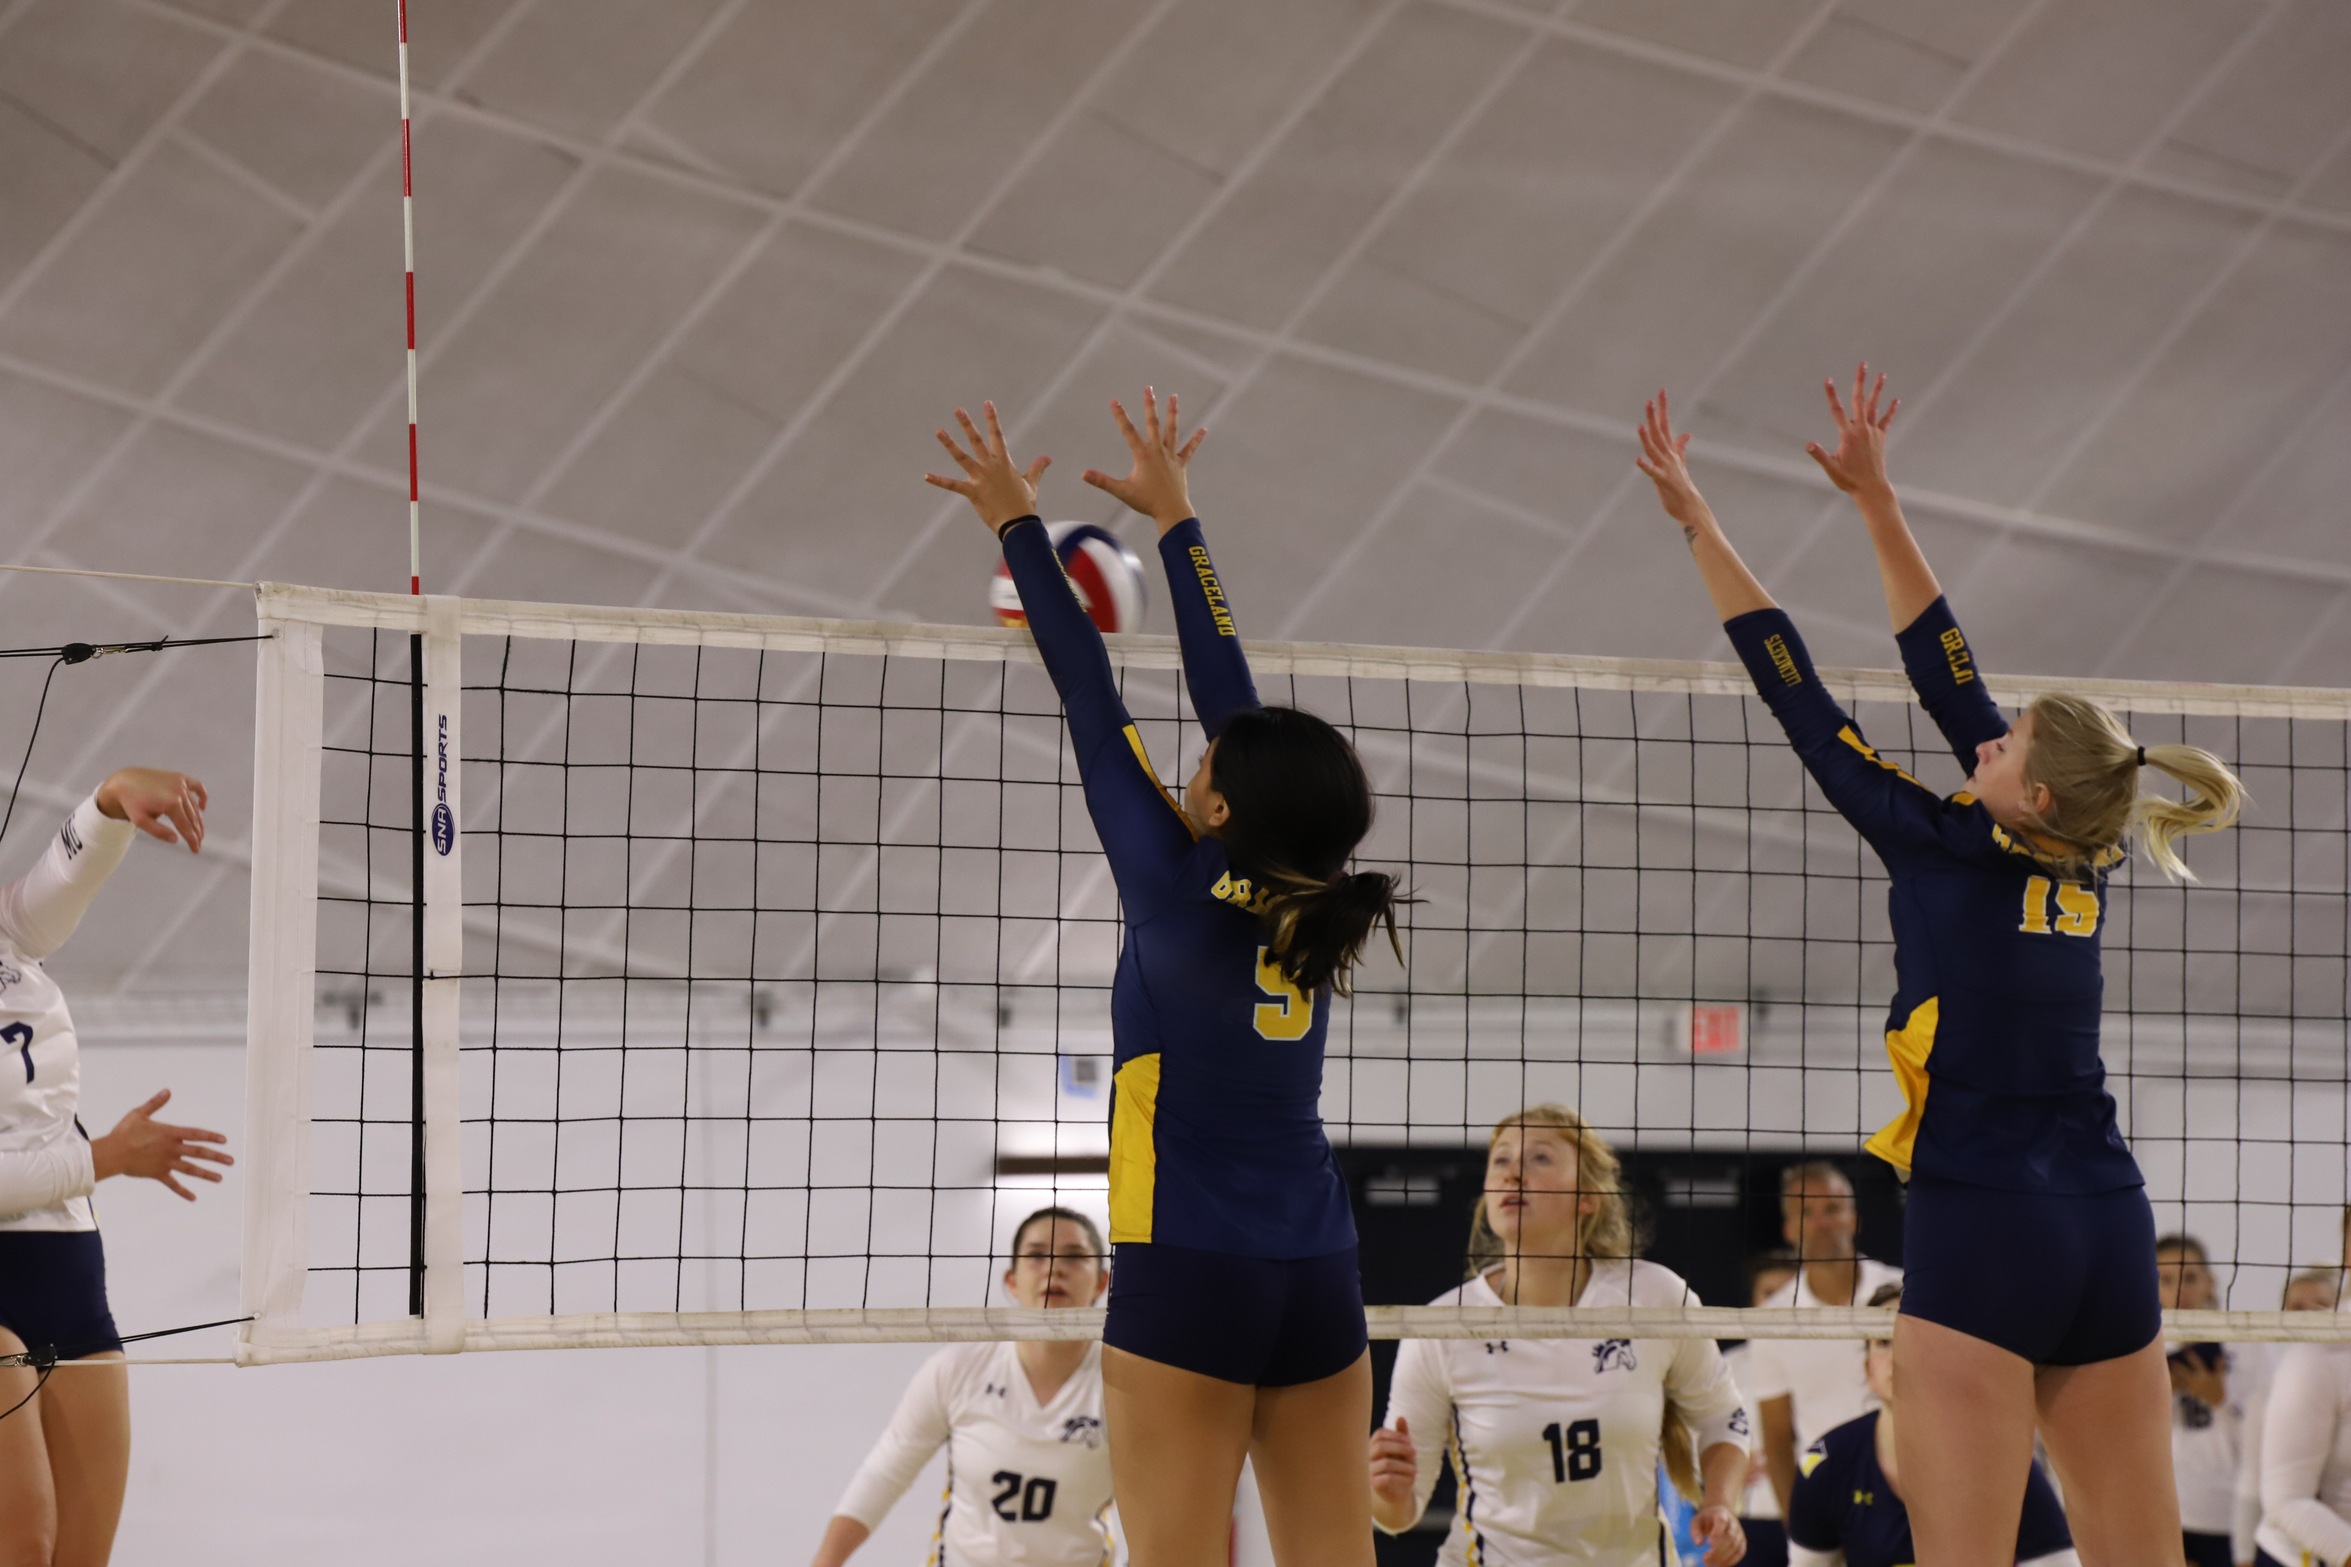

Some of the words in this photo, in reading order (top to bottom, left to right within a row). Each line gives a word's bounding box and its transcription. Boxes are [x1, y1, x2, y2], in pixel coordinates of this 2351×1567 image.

[1188, 545, 1237, 636] GRACELAND
[437, 713, 448, 804] SPORTS
[2019, 875, 2100, 937] 15
[1253, 945, 1315, 1041] 5
[0, 1020, 35, 1084] 7
[1542, 1418, 1603, 1484] 18
[991, 1470, 1057, 1523] 20
